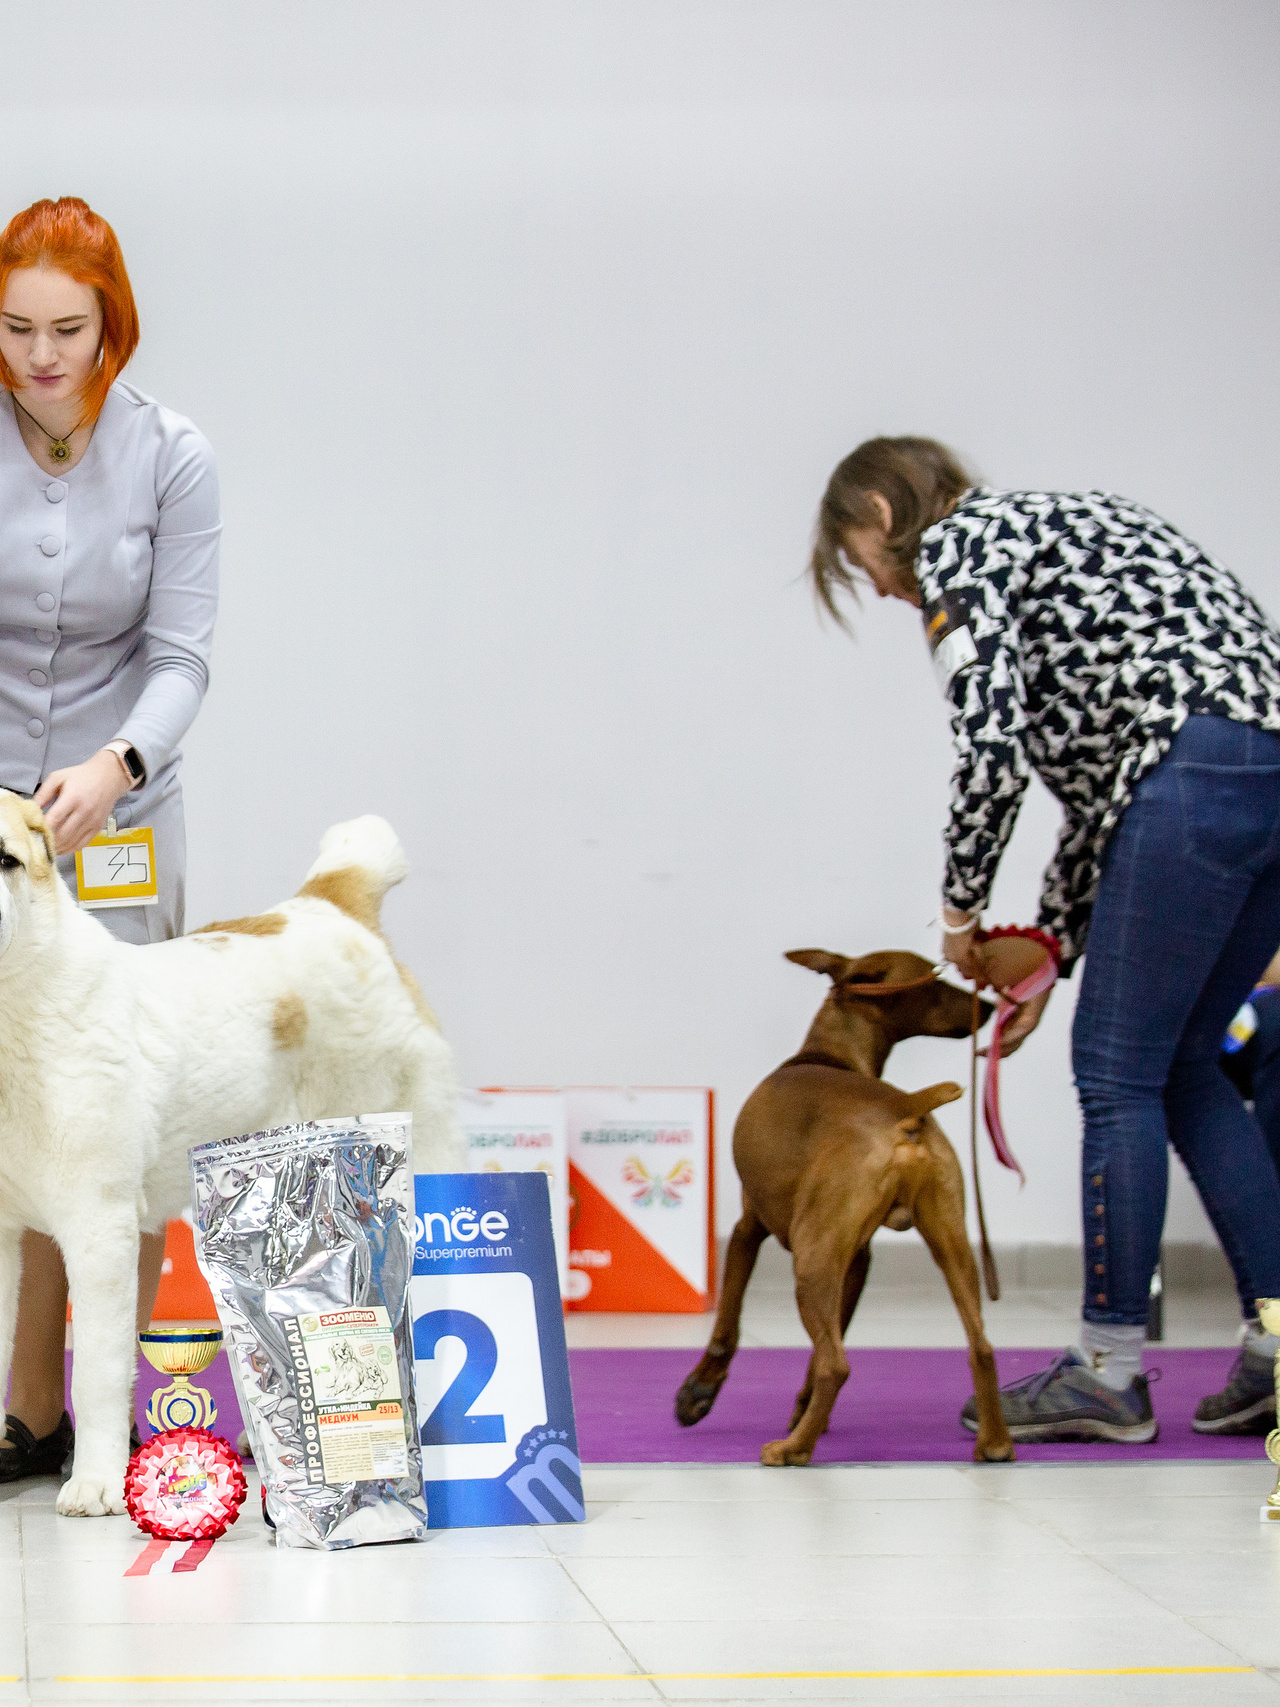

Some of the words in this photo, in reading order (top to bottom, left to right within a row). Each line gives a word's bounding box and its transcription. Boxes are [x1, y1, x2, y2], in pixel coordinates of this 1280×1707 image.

[106, 844, 148, 884] 35
[415, 1244, 513, 1262] Superpremium
[413, 1309, 507, 1446] 2
[284, 1318, 324, 1482] ПРОФЕССИОНАЛ
[379, 1405, 399, 1414] 25/13
[320, 1413, 359, 1425] МЕДИУМ
